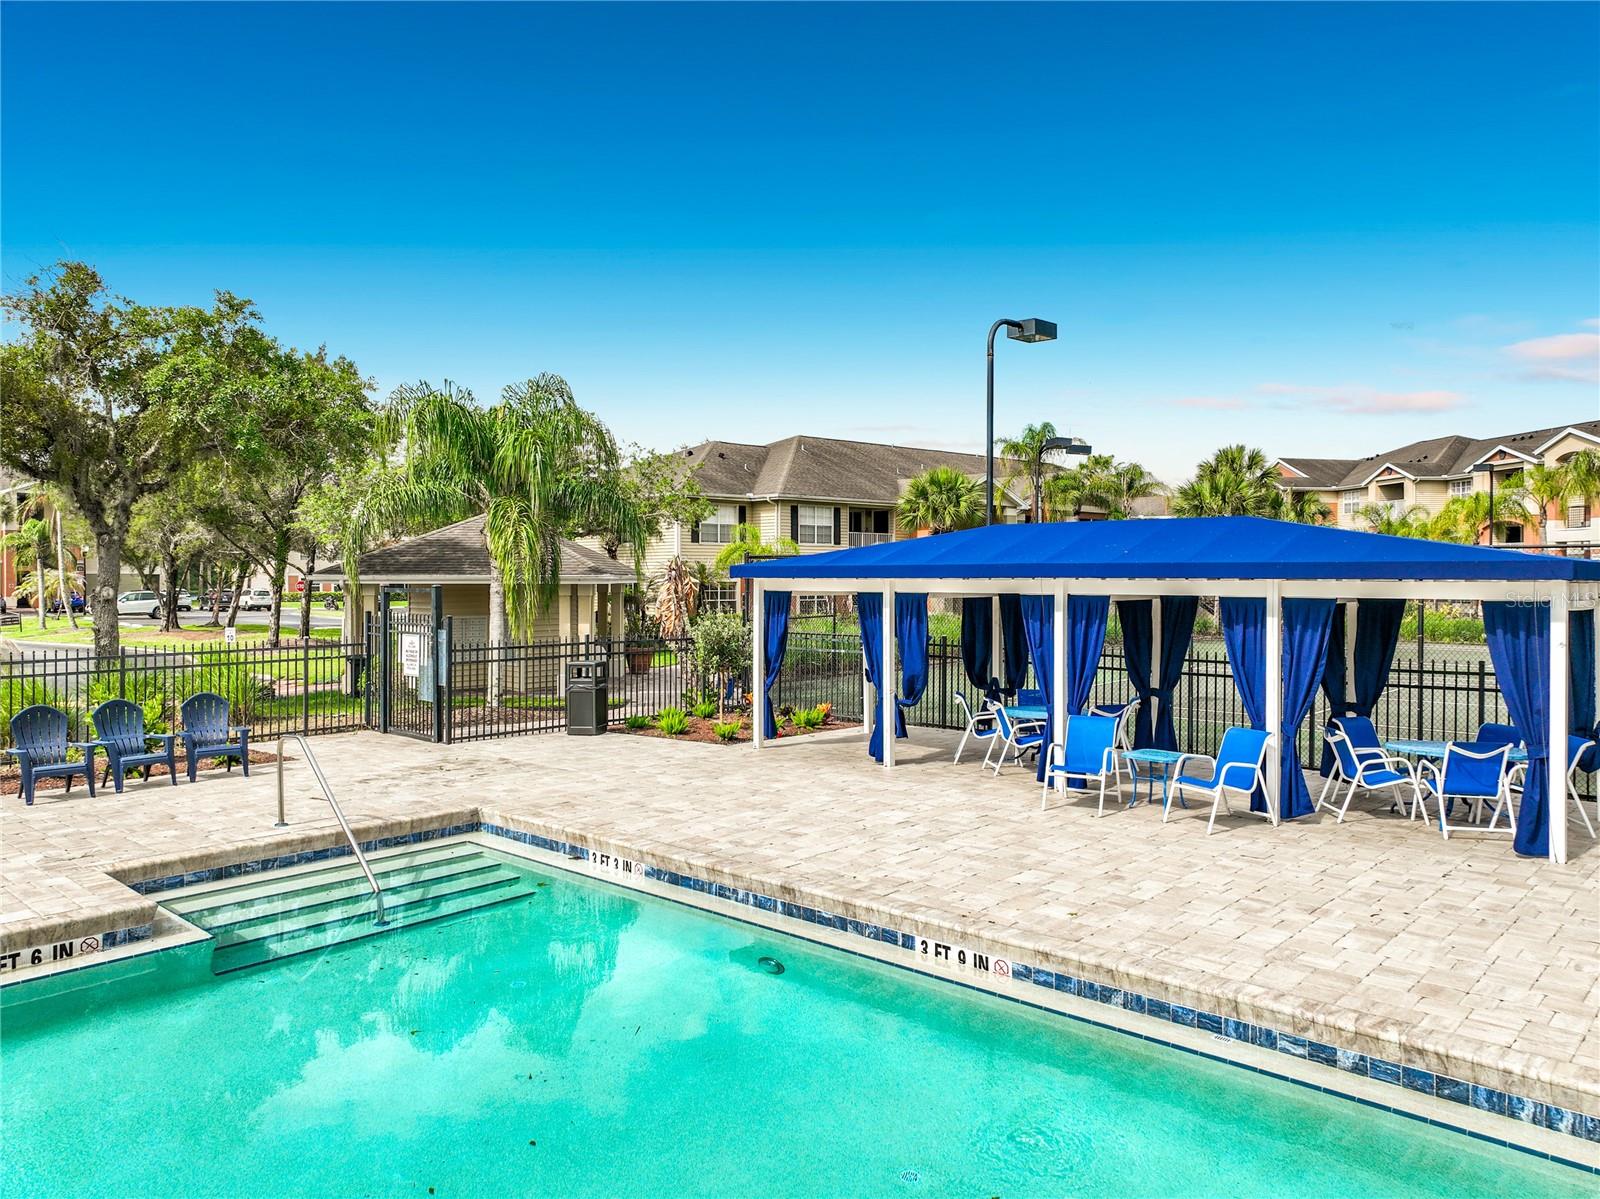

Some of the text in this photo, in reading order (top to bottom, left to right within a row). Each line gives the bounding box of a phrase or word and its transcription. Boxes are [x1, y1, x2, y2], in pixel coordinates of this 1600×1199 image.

[600, 853, 610, 867] FT
[622, 859, 632, 873] IN
[31, 948, 42, 965] 6
[53, 941, 73, 961] IN
[920, 940, 989, 971] 3 FT 9 IN
